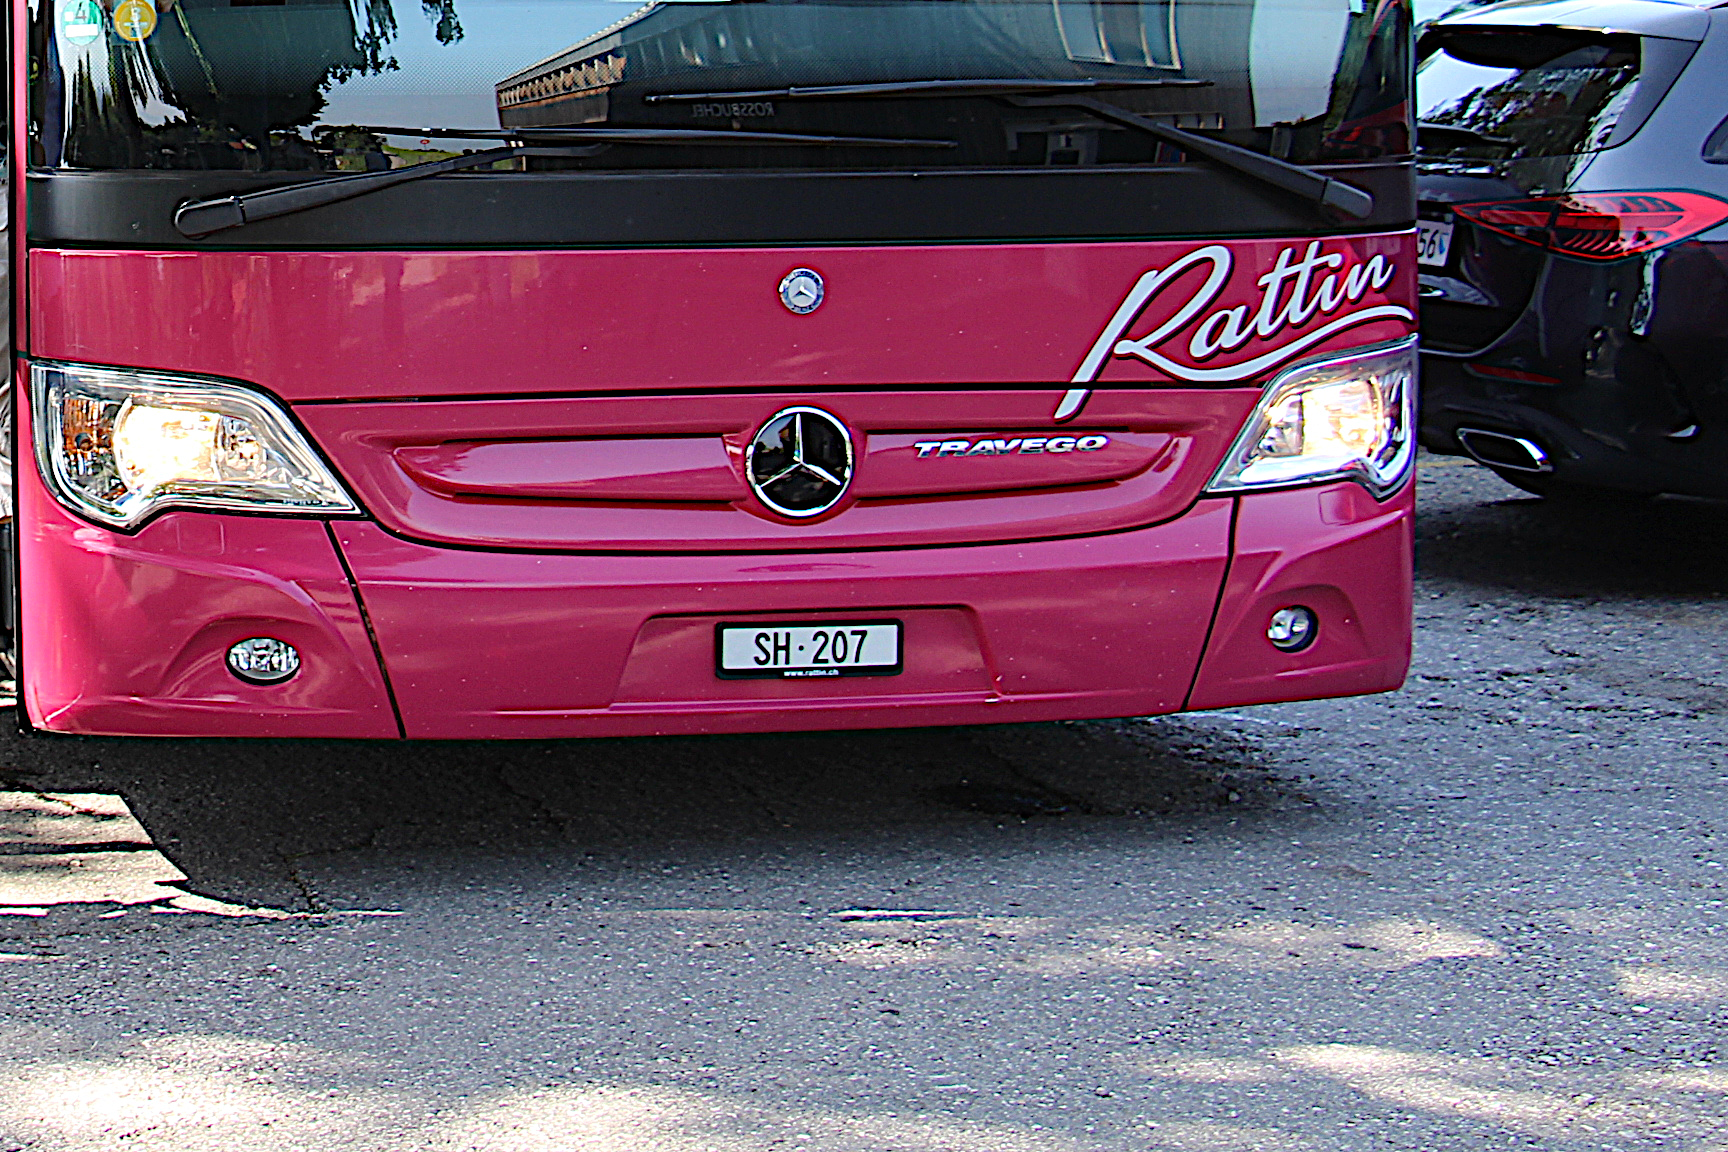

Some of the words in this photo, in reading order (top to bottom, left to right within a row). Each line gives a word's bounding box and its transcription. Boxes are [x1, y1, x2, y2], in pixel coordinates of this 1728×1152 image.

[1054, 240, 1414, 422] Rattin
[913, 435, 1109, 459] TRAVEGO
[783, 668, 840, 677] www.rattin.ch
